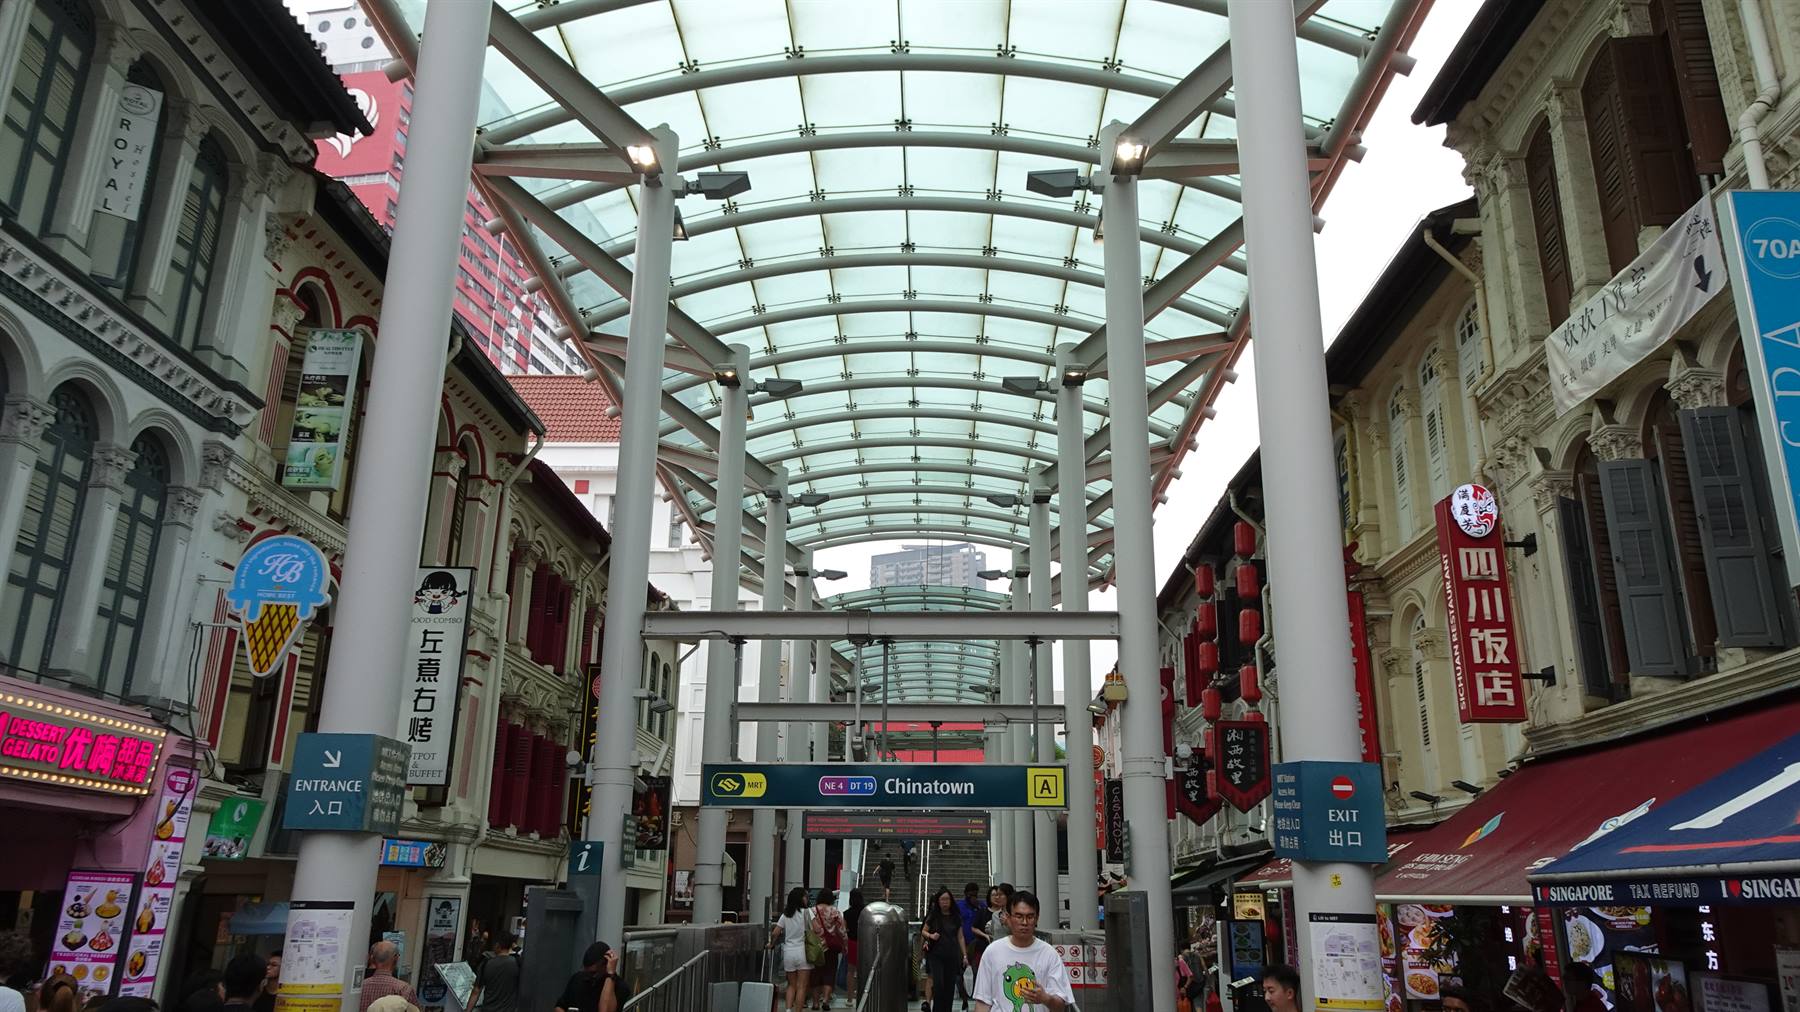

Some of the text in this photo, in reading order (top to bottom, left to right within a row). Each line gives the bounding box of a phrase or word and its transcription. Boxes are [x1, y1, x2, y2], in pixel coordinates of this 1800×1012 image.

[102, 118, 131, 211] ROYAL
[1752, 238, 1800, 259] 70A
[1563, 265, 1648, 354] 欢欢工作室
[1440, 553, 1467, 711] SICHUAN RESTAURANT
[1458, 547, 1516, 707] 四川饭店
[407, 629, 445, 743] 左煮右烤
[8, 717, 68, 743] DESSERT
[2, 737, 59, 763] GELATO
[411, 752, 437, 761] TPOT
[409, 769, 444, 778] BUFFET
[295, 779, 362, 792] ENTRANCE
[747, 781, 764, 789] MRT
[824, 781, 874, 790] NE 4 DT 19
[884, 778, 975, 795] Chinatown
[1040, 778, 1052, 794] A
[308, 800, 343, 815] 入口
[1328, 809, 1360, 822] EXIT
[1112, 786, 1122, 854] CASANOVA
[1328, 829, 1362, 847] 出口
[1536, 884, 1614, 902] I SINGAPORE
[1629, 882, 1700, 899] TAX REFUND
[1719, 879, 1729, 898] I
